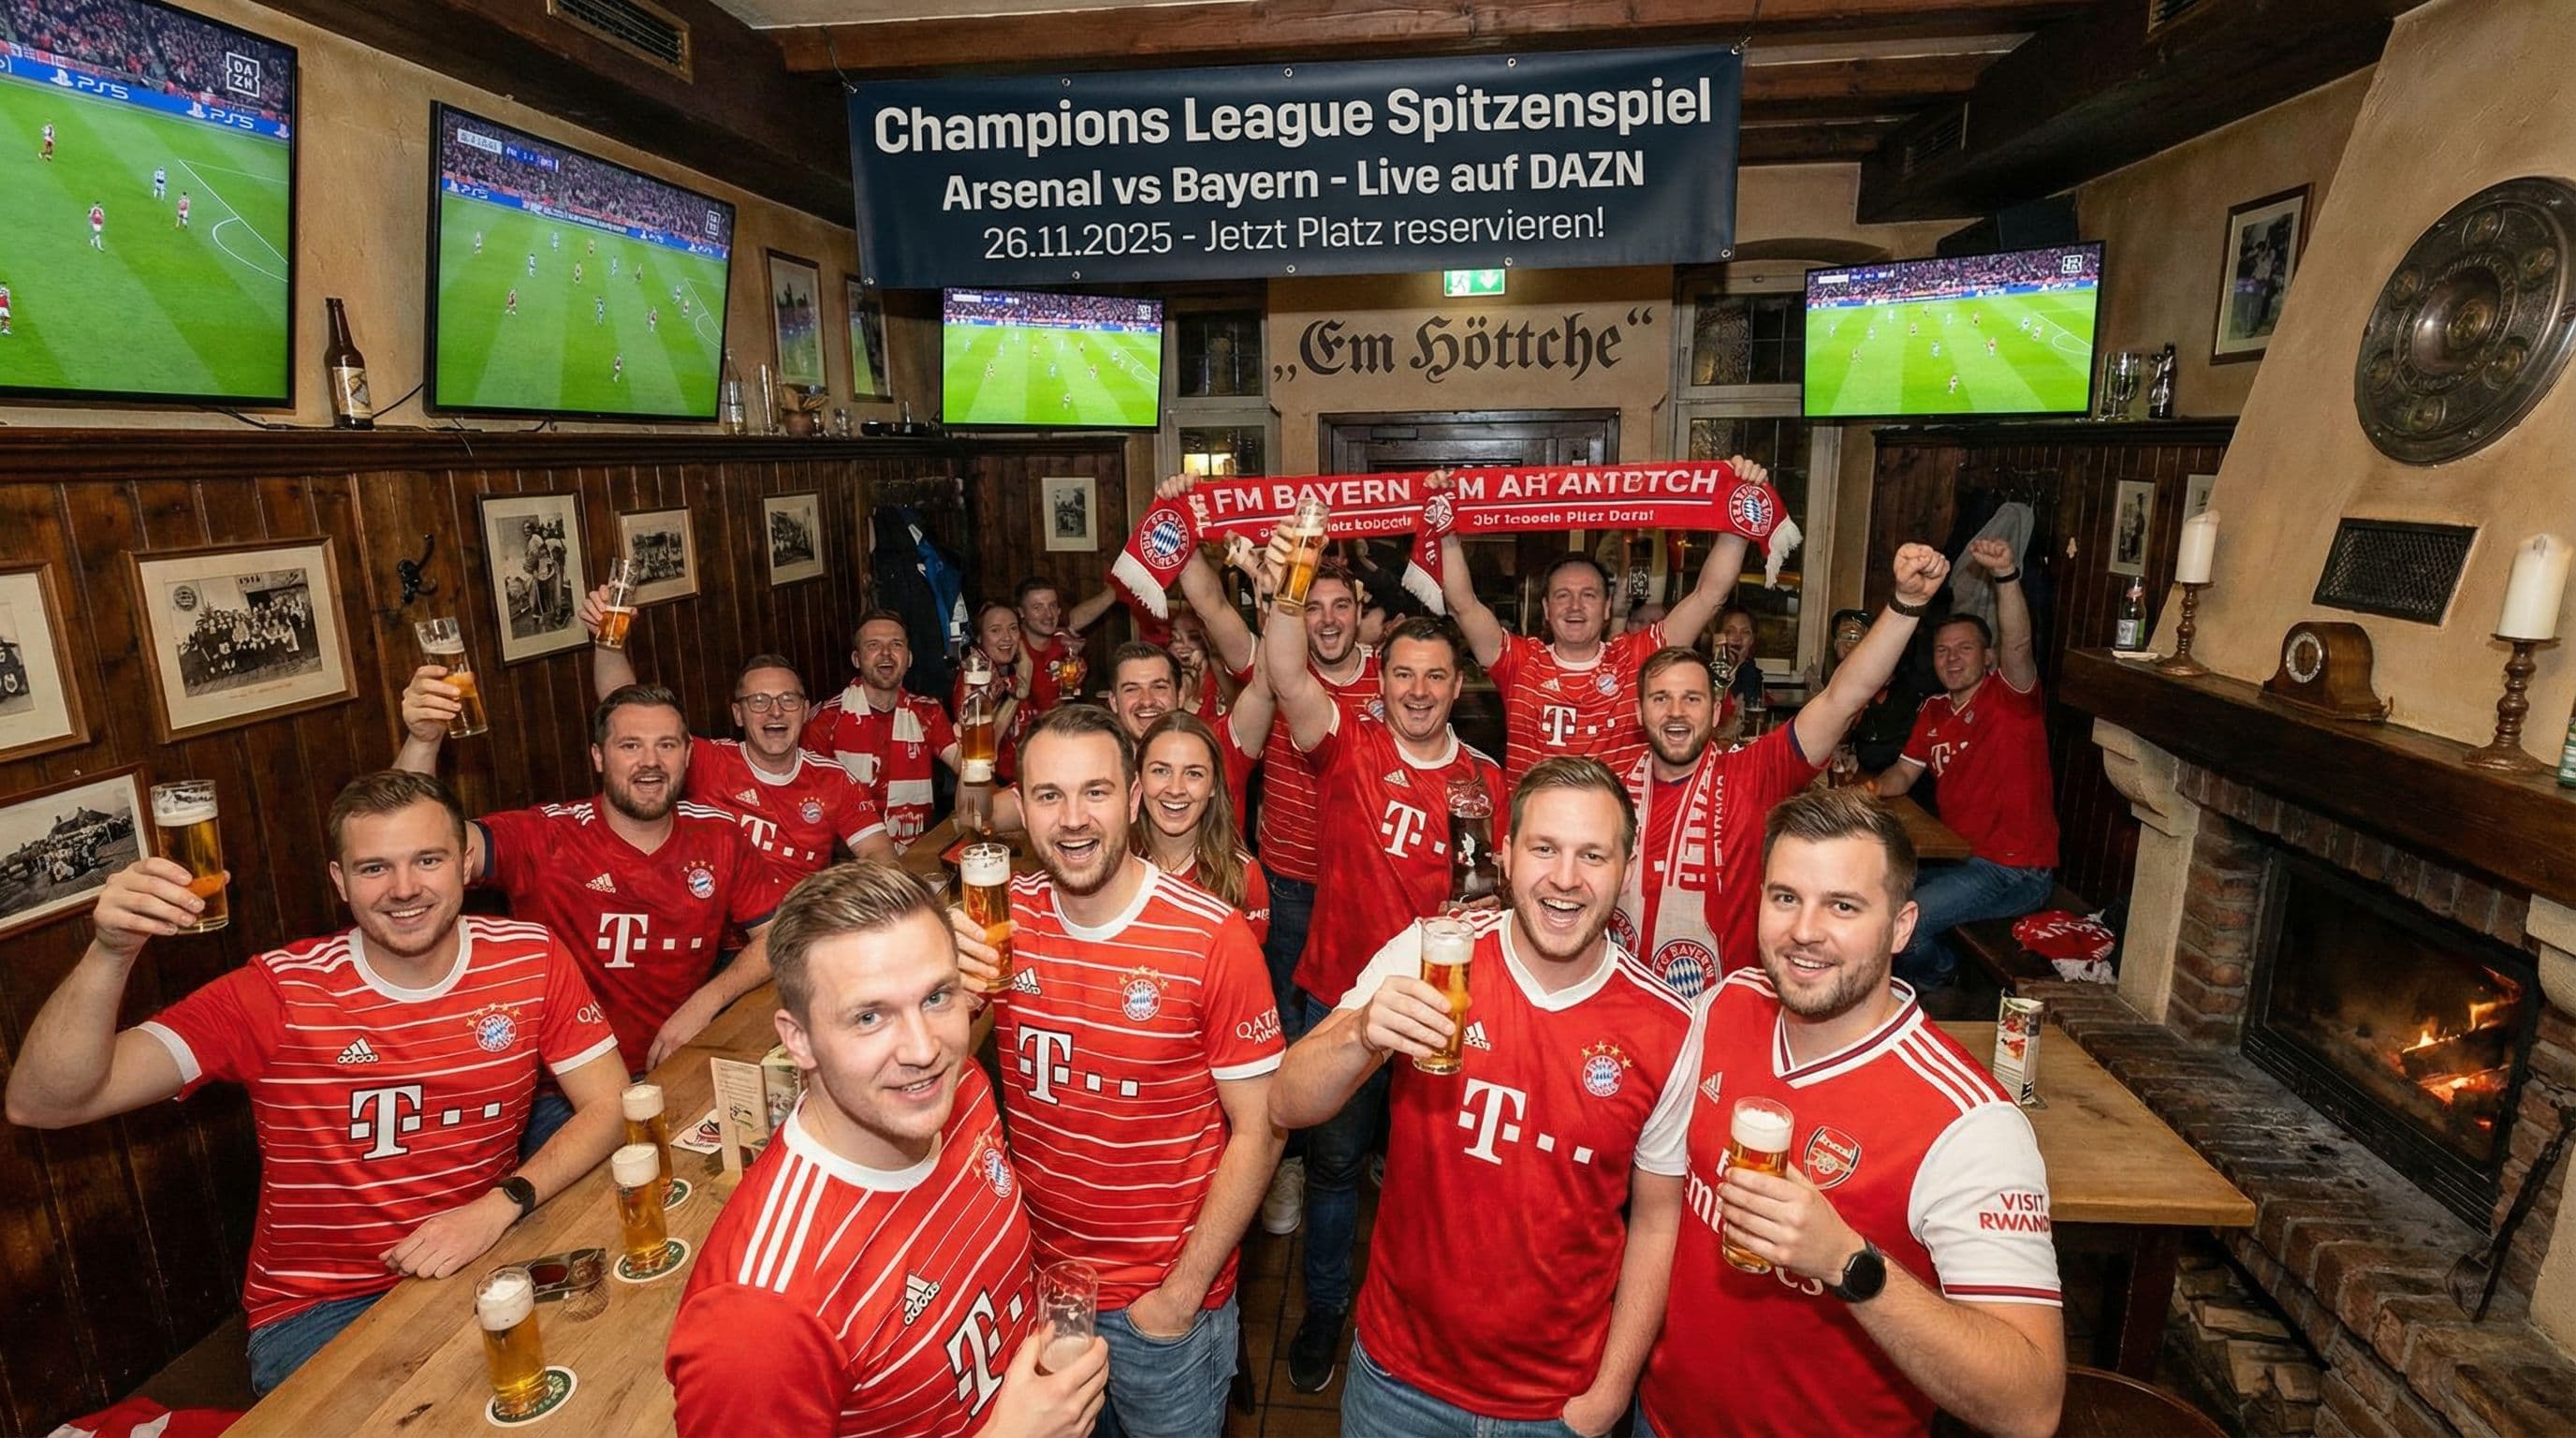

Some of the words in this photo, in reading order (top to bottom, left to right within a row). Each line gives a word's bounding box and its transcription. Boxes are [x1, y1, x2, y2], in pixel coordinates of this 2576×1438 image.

[875, 98, 1170, 158] Champions
[1184, 96, 1373, 148] League
[1387, 77, 1711, 143] Spitzenspiel
[943, 169, 1103, 211] Arsenal
[1111, 175, 1162, 206] vs
[1172, 167, 1319, 209] Bayern
[1330, 175, 1347, 184] -
[1357, 157, 1440, 196] Live
[1451, 154, 1519, 194] auf
[1530, 150, 1644, 191] DAZN
[984, 221, 1172, 259] 26.11.2025
[1204, 219, 1288, 252] Jetzt
[1298, 215, 1383, 248] Platz
[1394, 206, 1603, 245] reservieren!
[1272, 478, 1411, 511] BAYERN
[1542, 704, 1577, 747] T
[1382, 799, 1427, 859] T
[597, 912, 649, 969] T
[1017, 1024, 1074, 1106] T
[350, 1083, 422, 1161] T
[1458, 1077, 1528, 1167] T
[1999, 1193, 2044, 1213] VISIT
[944, 1288, 1006, 1418] T
